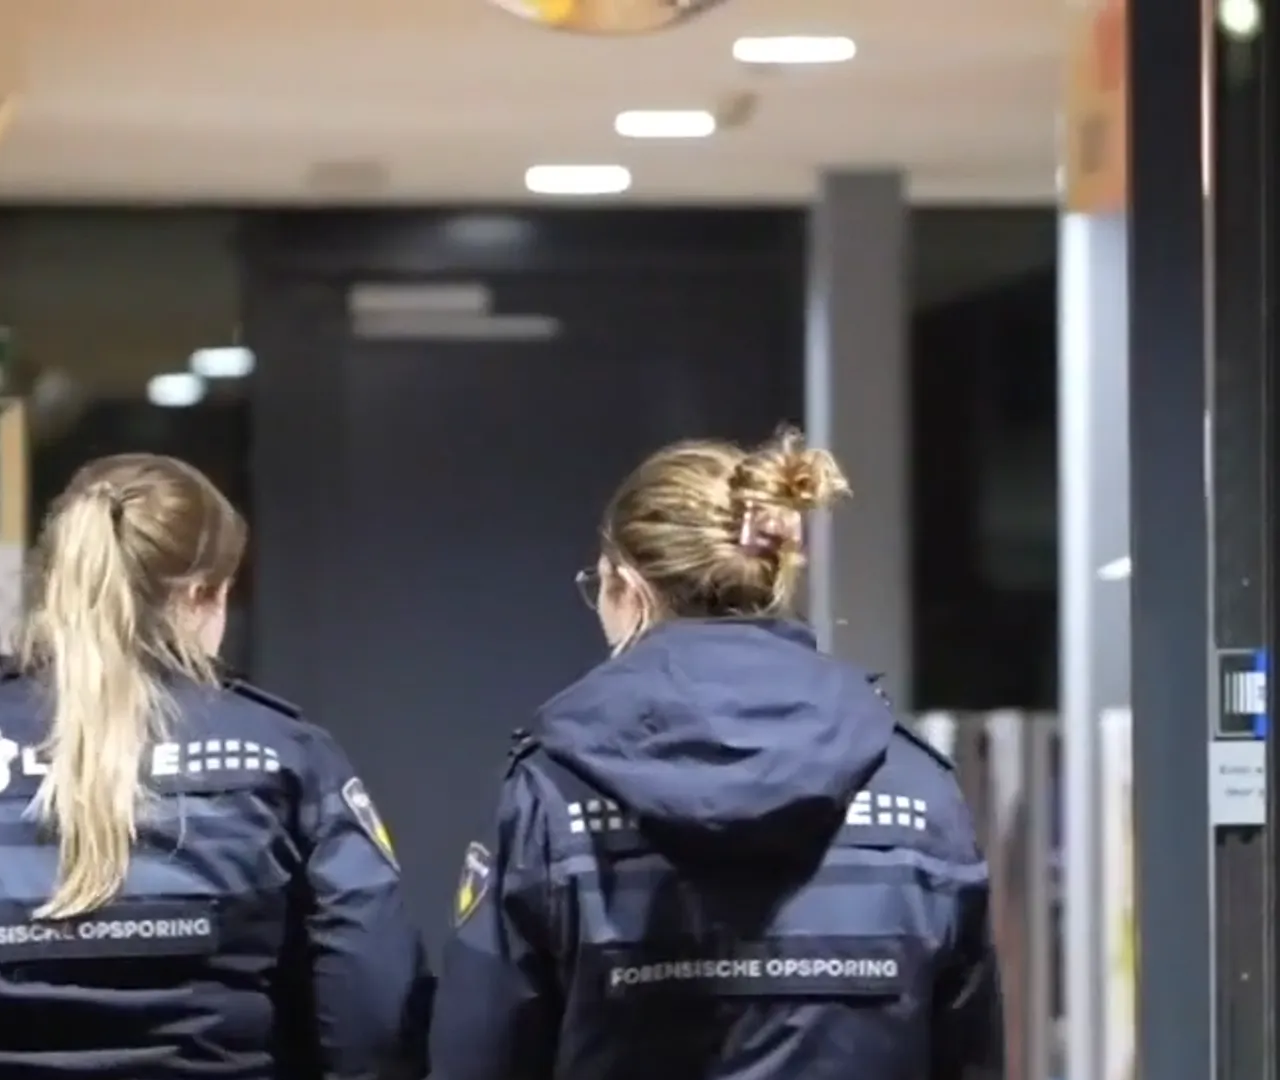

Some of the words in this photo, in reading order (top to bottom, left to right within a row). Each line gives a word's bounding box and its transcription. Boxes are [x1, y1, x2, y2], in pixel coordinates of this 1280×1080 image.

[78, 918, 211, 940] OPSPORING
[610, 959, 762, 987] FORENSISCHE
[765, 957, 899, 979] OPSPORING
